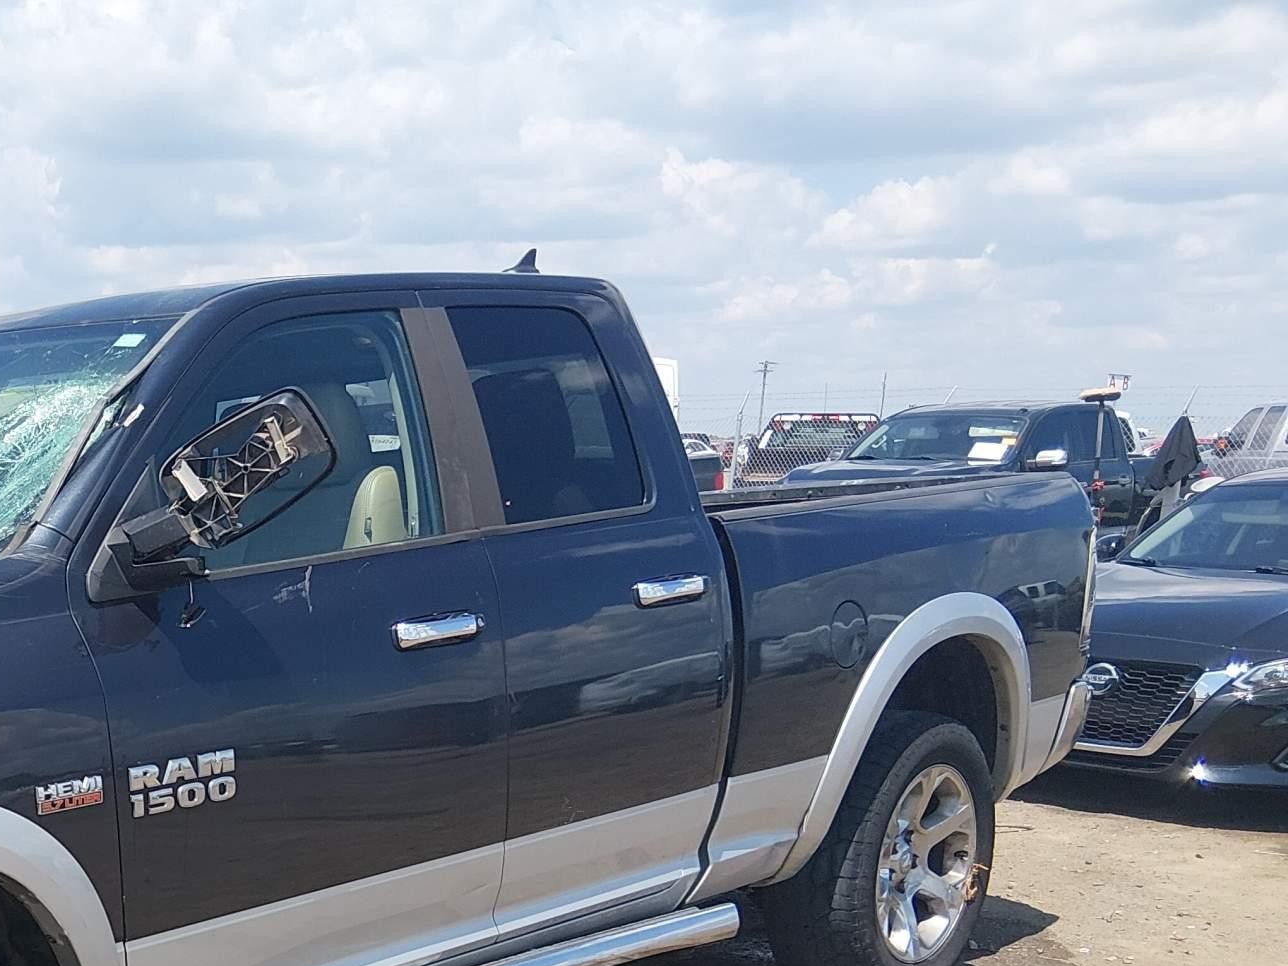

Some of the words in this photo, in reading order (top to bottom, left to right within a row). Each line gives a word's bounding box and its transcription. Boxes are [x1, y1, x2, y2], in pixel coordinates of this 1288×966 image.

[35, 775, 103, 800] HEMI
[127, 748, 235, 791] RAM
[129, 775, 237, 818] 1500
